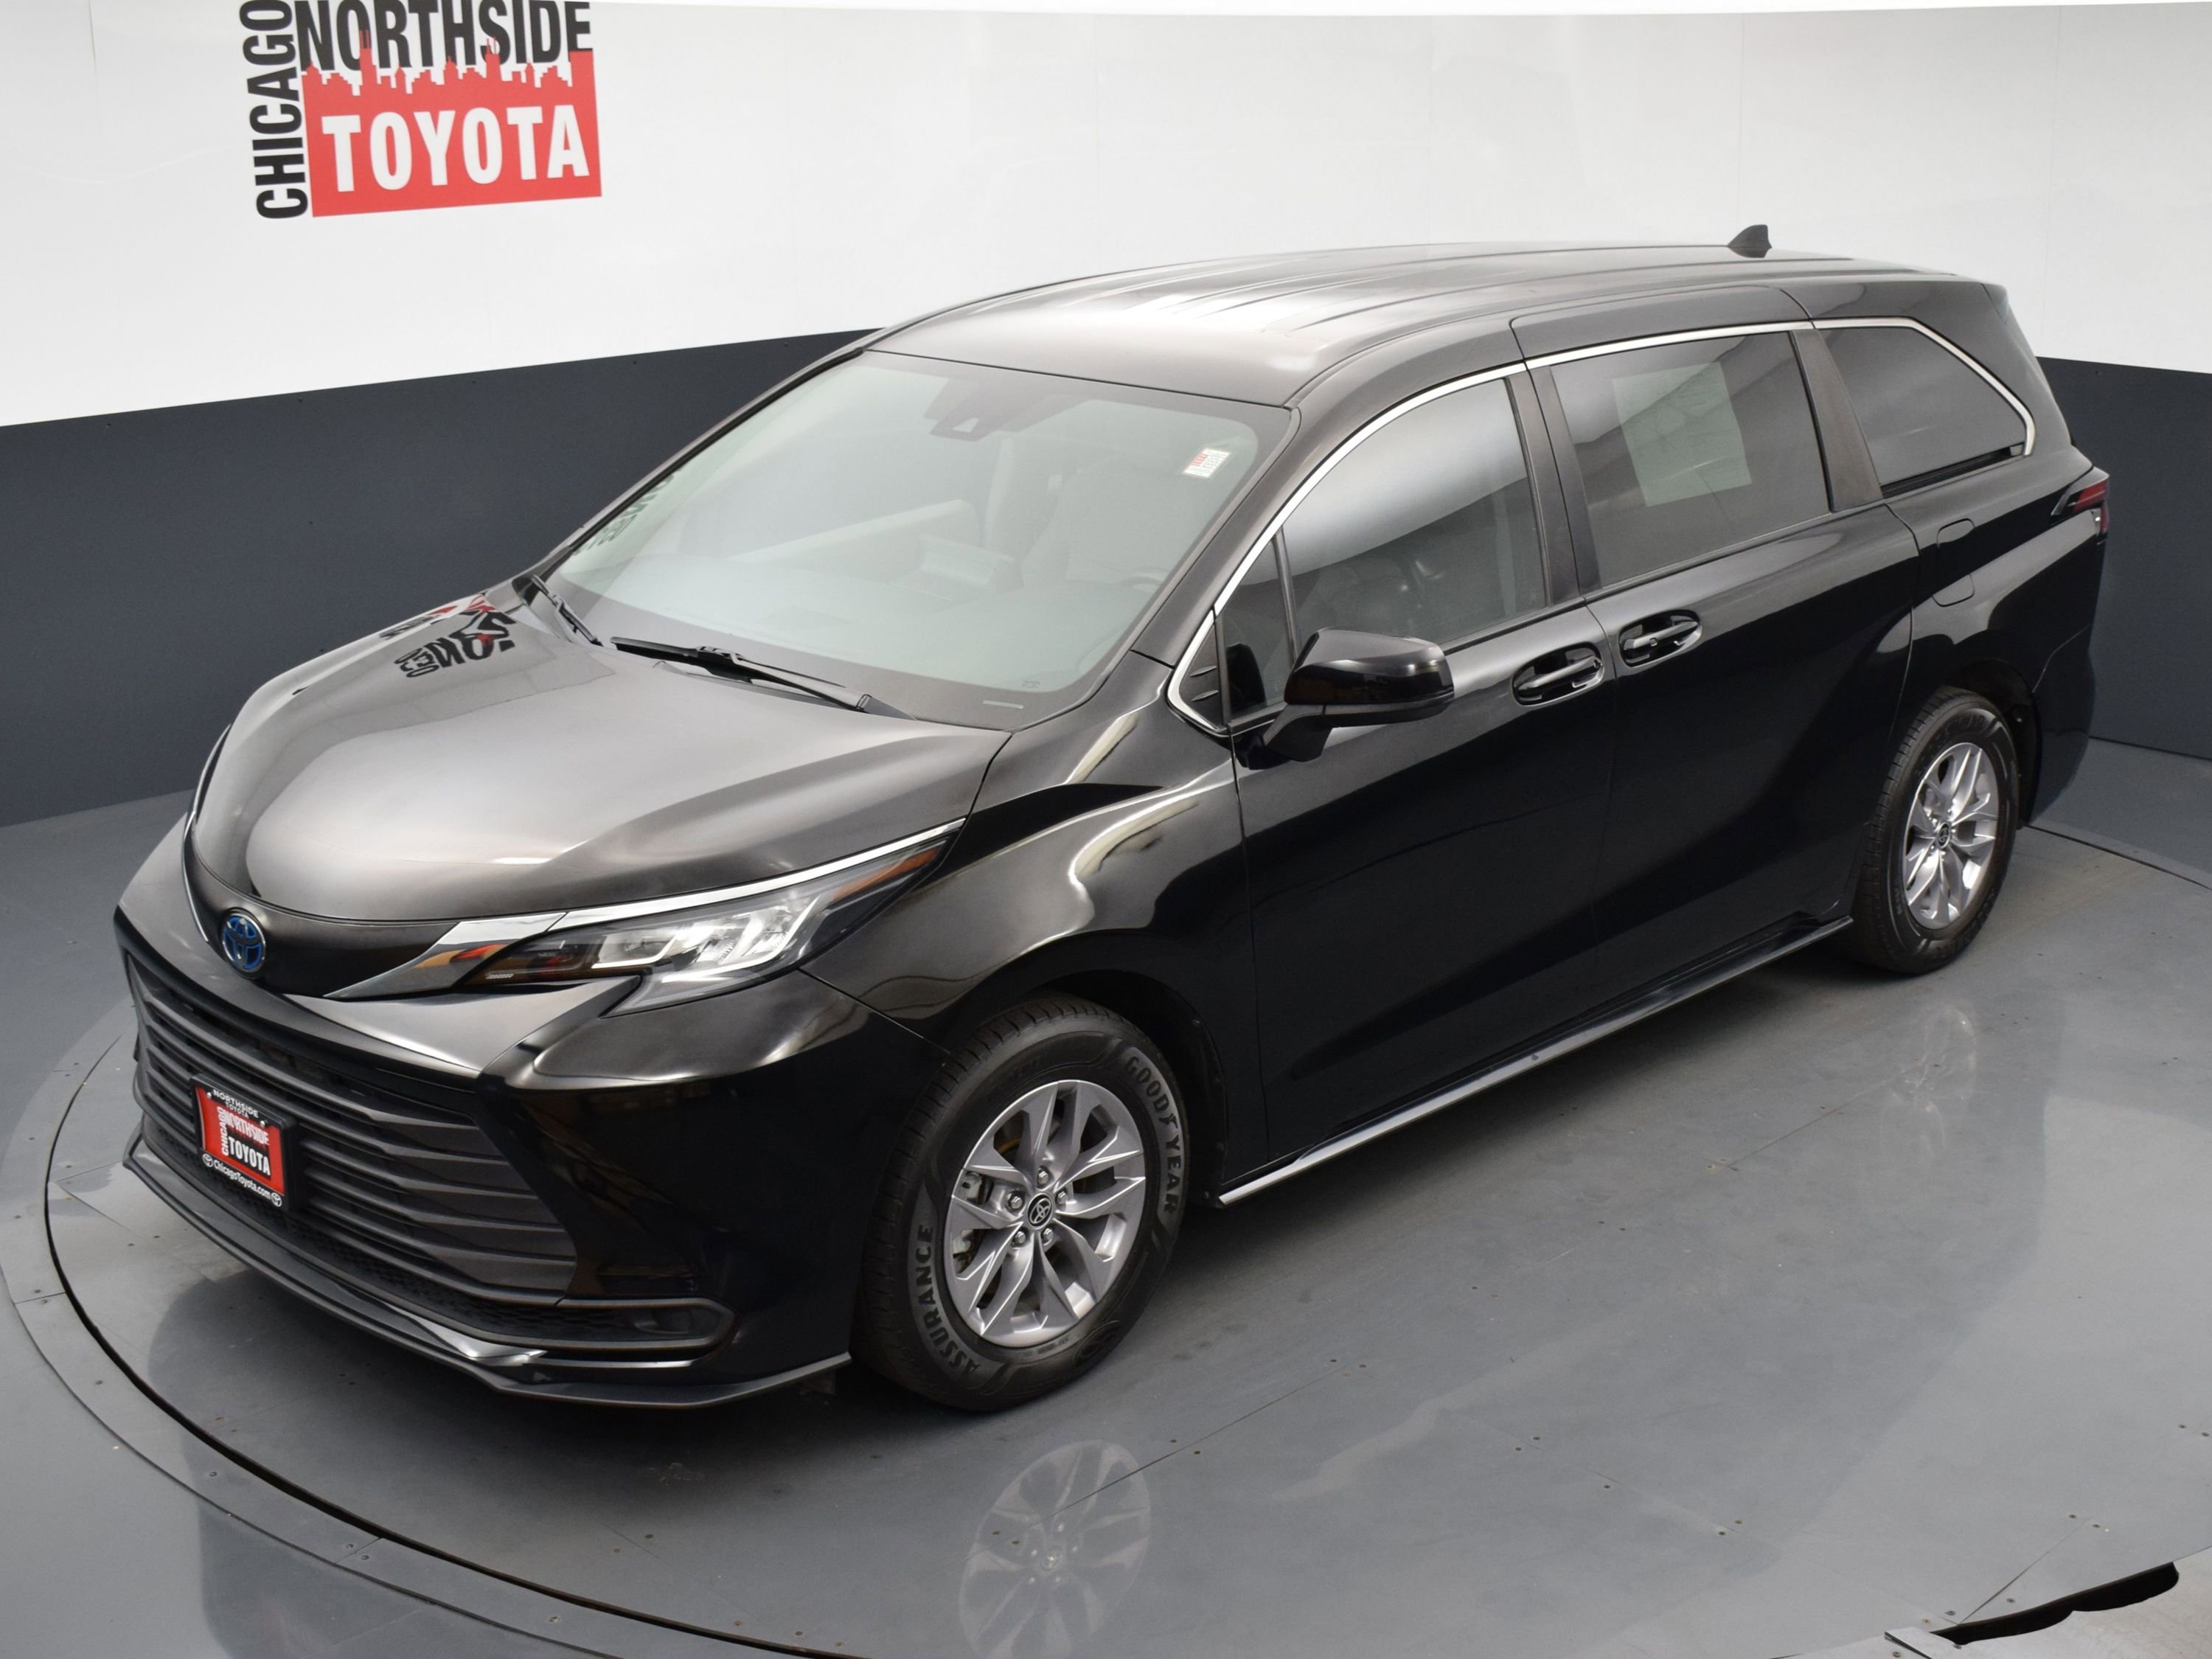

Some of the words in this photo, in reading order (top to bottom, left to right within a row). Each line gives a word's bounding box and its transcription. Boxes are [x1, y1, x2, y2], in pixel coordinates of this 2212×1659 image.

[295, 0, 593, 71] NORTHSIDE
[239, 0, 308, 219] CHICAGO
[321, 105, 590, 192] TOYOTA
[213, 1090, 258, 1118] NORTHSIDE
[223, 1110, 270, 1145] NORTHSIDE
[226, 1102, 249, 1119] TOYOTA
[218, 1107, 229, 1156] CHICAGO
[228, 1136, 271, 1175] TOYOTA
[915, 1224, 981, 1373] ASSURANCE
